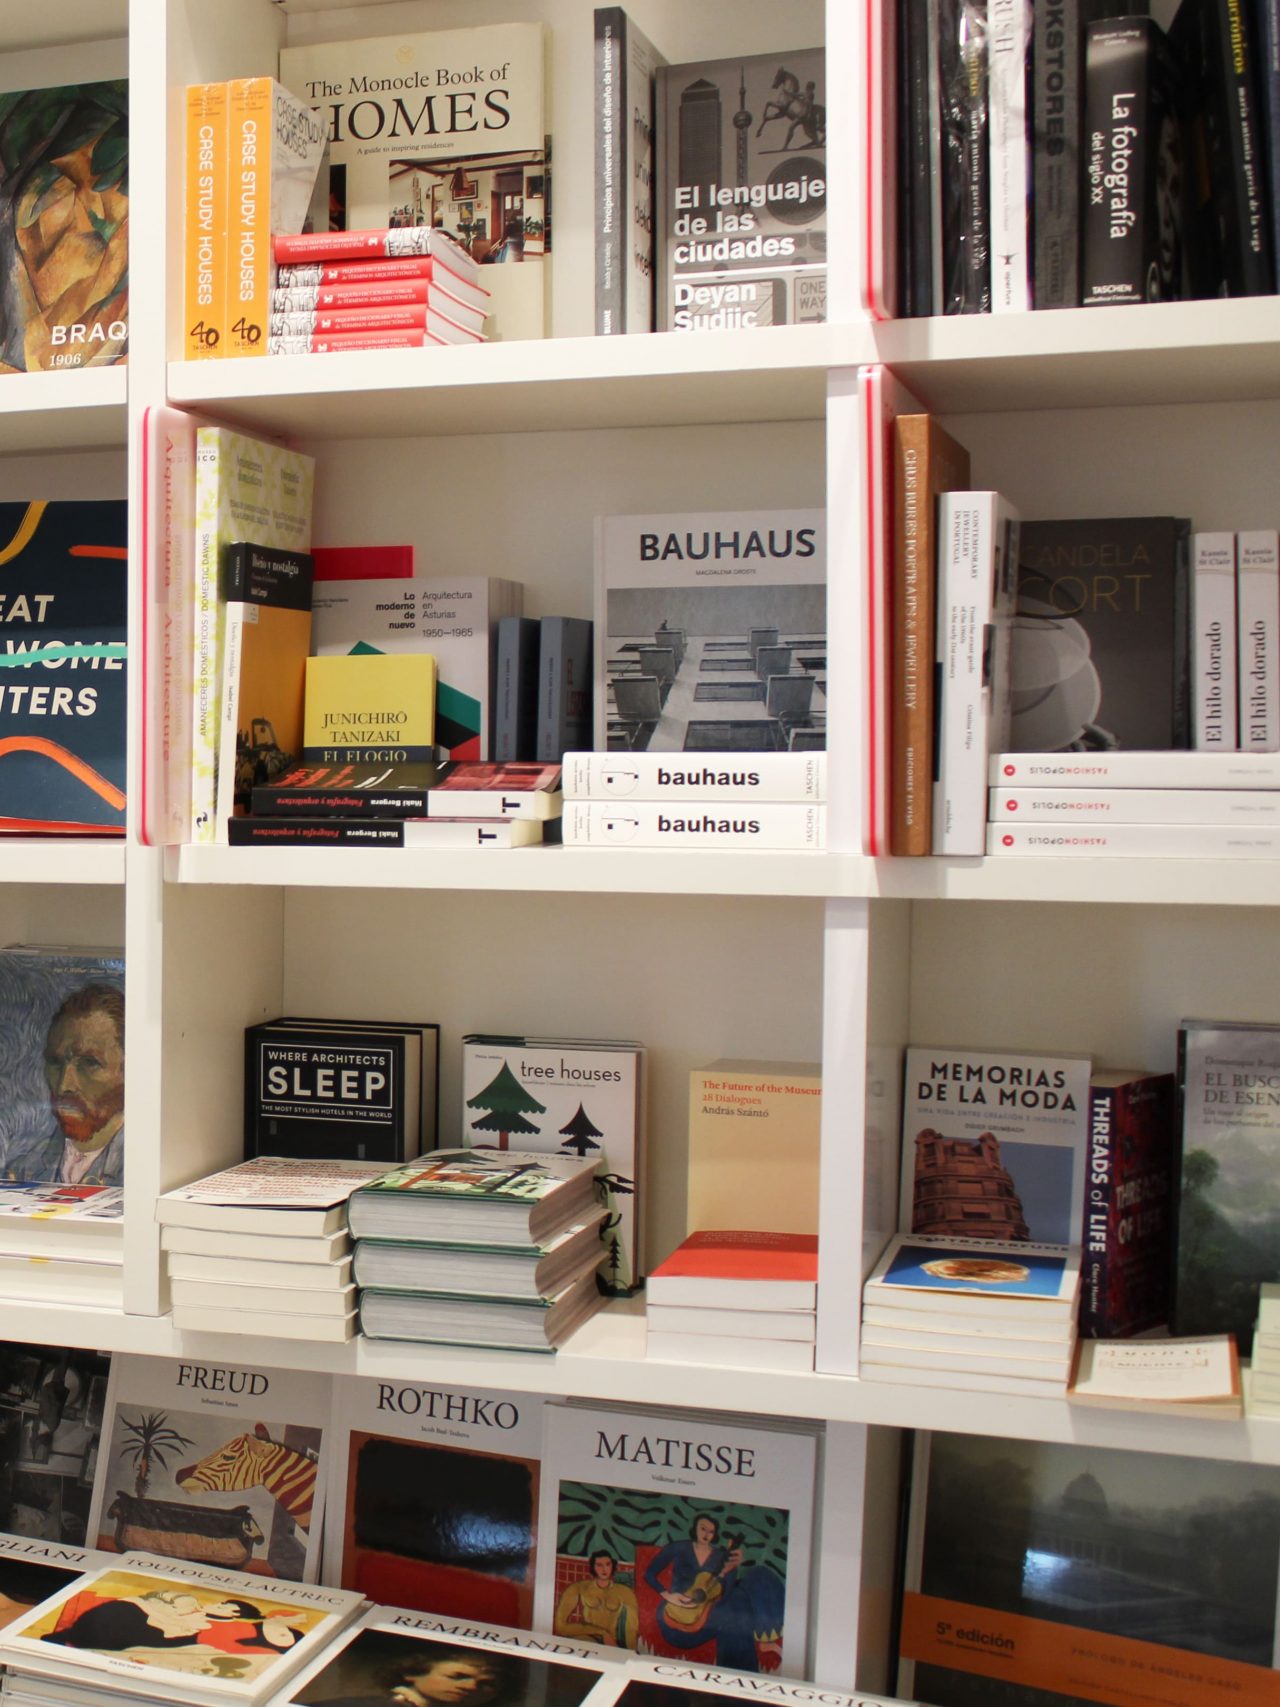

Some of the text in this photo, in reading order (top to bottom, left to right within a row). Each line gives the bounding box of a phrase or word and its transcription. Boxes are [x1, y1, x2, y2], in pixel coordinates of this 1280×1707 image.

[306, 62, 510, 98] The Monocle Book of
[199, 125, 214, 171] CASE
[242, 120, 257, 166] CASE
[1088, 131, 1105, 184] del siglo
[1104, 93, 1138, 239] La fotografía
[199, 176, 214, 230] STUDY
[241, 171, 256, 226] STUDY
[675, 176, 826, 209] El lenguaje
[674, 211, 755, 236] de las
[674, 235, 795, 264] ciudades
[198, 236, 213, 304] HOUSES
[240, 232, 255, 301] HOUSES
[674, 284, 757, 308] Deyan
[800, 282, 826, 295] ONE
[49, 320, 128, 347] BRAQ
[190, 320, 220, 346] 40
[231, 317, 261, 343] 40
[49, 353, 82, 367] 1906
[640, 528, 816, 561] BAUHAUS
[904, 539, 917, 618] PORTRAITS
[376, 602, 415, 610] moderno
[404, 592, 415, 600] Lo
[422, 591, 472, 602] Arquitectura
[404, 611, 415, 619] de
[422, 610, 456, 619] Asturias
[1206, 621, 1222, 742] El hilo dorado
[1250, 620, 1267, 742] El hilo dorado
[199, 682, 208, 736] AMANECERES
[329, 730, 401, 743] TANIZAKI
[657, 768, 760, 786] bauhaus
[1030, 766, 1108, 775] FASHIONOPOLIS
[370, 799, 401, 808] Bergera
[1032, 802, 1110, 811] FASHIONOPOLIS
[658, 815, 761, 833] bauhaus
[1028, 837, 1106, 846] FASHIONOPOLIS
[268, 1050, 386, 1066] WHERE ARCHITECTS
[521, 1058, 622, 1082] tree houses
[267, 1065, 386, 1100] SLEEP
[702, 1080, 782, 1094] The Future of the
[931, 1062, 1066, 1089] MEMORIAS
[1204, 1073, 1228, 1087] EL
[715, 1095, 762, 1106] Dialogues
[917, 1082, 1077, 1111] DE LA MODA
[1204, 1090, 1280, 1106] DE ESEN
[294, 1106, 320, 1114] STYLISH
[320, 1108, 345, 1116] HOTELS
[368, 1111, 392, 1119] WORLD
[702, 1106, 769, 1118] András Szántó
[1089, 1096, 1111, 1253] THREADS of LIFE
[176, 1363, 270, 1396] FREUD
[376, 1383, 520, 1430] ROTHKO
[594, 1430, 756, 1477] MATISSE
[124, 1556, 346, 1607] TOULOUSE-LAUTREC
[391, 1614, 599, 1660] REMBRANDT
[955, 1623, 1017, 1652] edición
[652, 1663, 884, 1707] CARAVAGGIO
